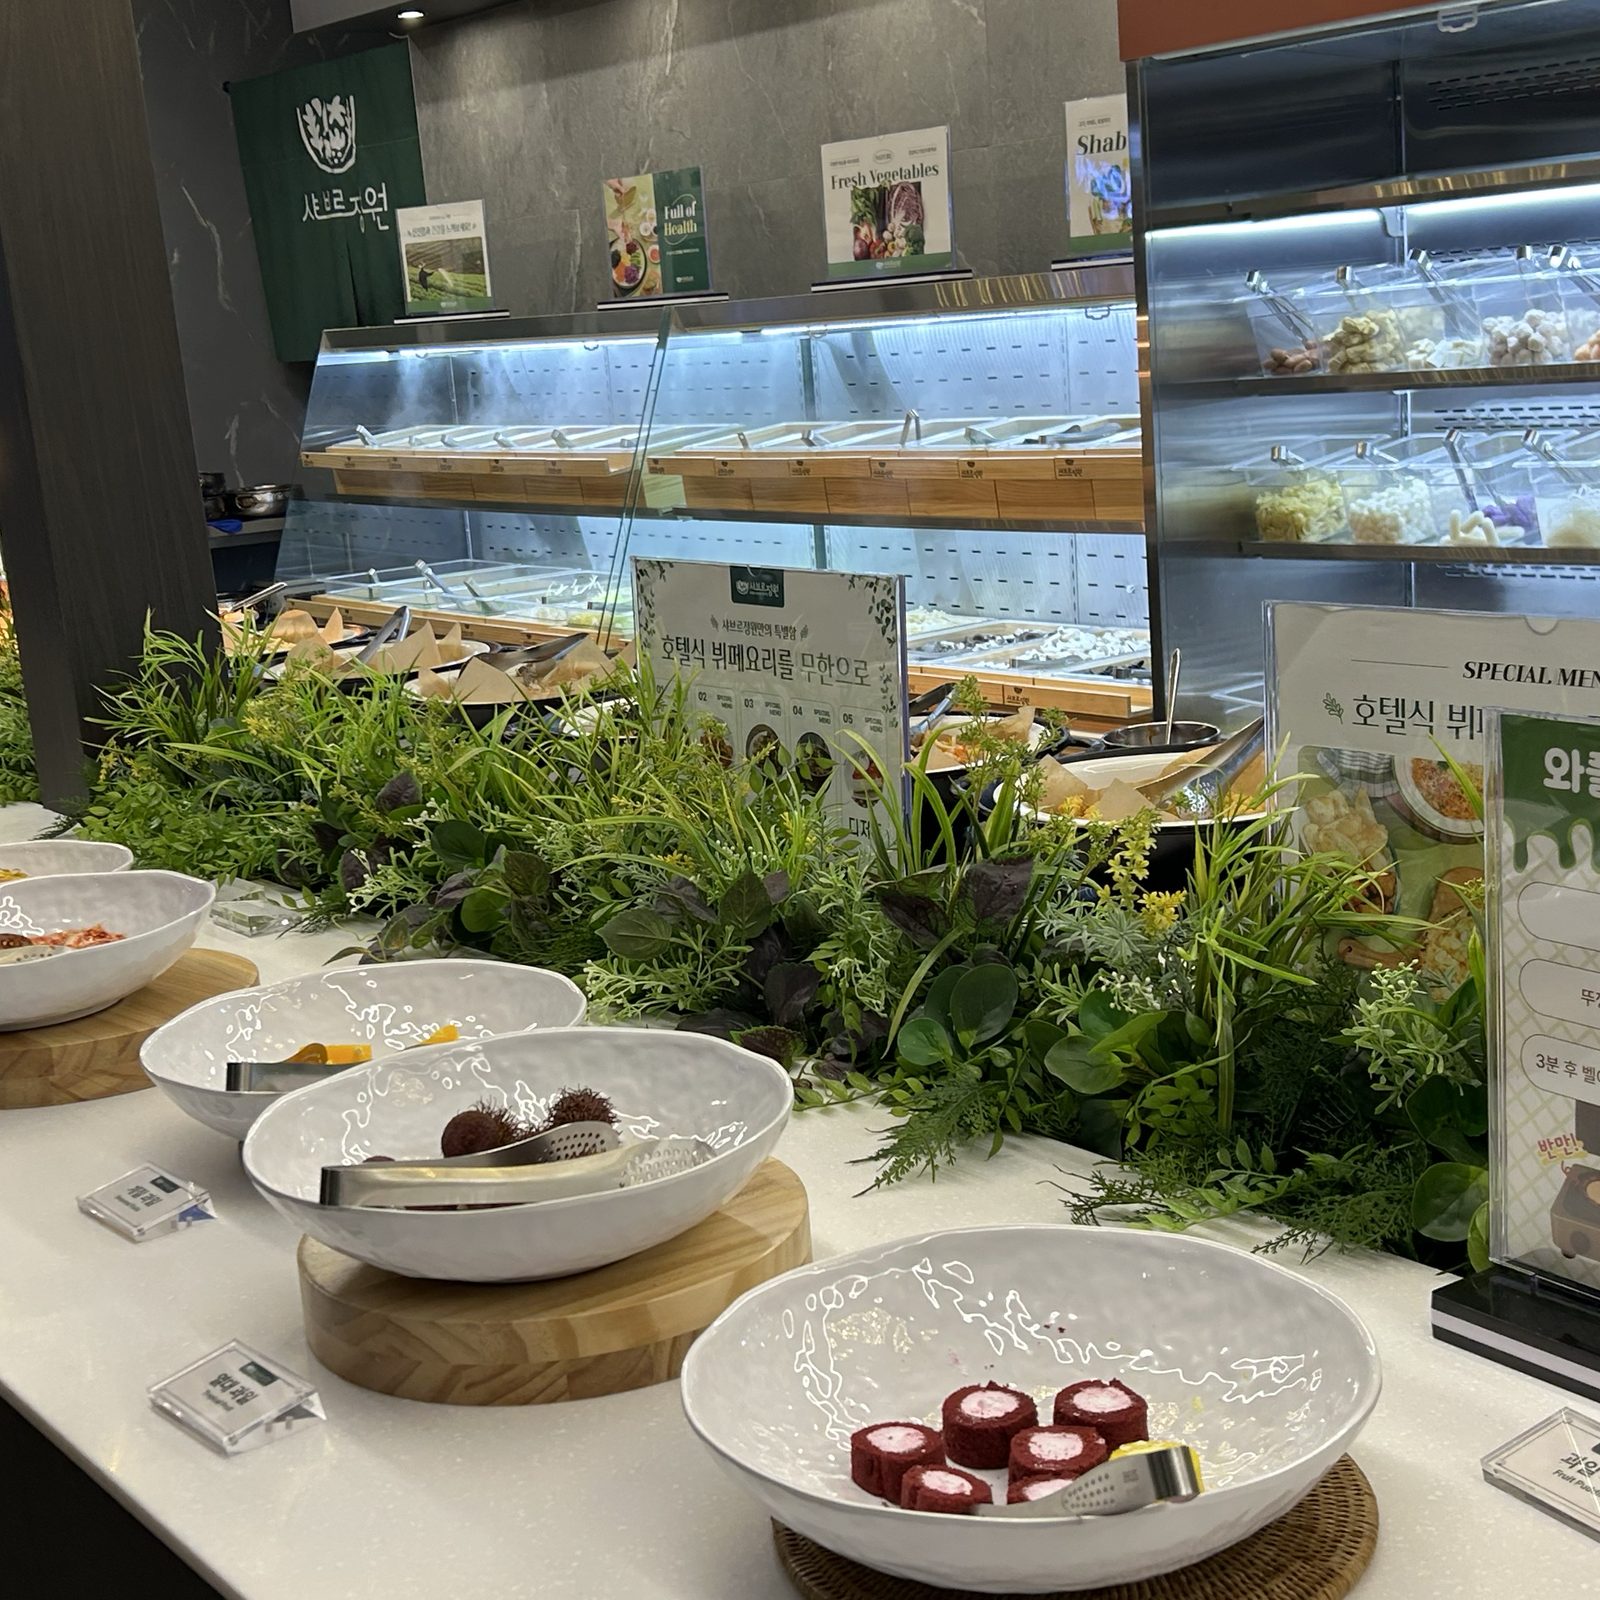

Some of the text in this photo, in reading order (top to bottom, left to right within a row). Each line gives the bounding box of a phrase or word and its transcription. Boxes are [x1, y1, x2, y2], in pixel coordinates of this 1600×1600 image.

[831, 163, 939, 190] Fresh Vegetables
[664, 200, 697, 220] Full of
[664, 219, 698, 236] Health
[721, 618, 797, 641] 샤브르정원만의 특별함
[661, 635, 872, 687] 호텔식 뷔페요리를 무한으로
[1462, 661, 1552, 685] SPECIAL
[698, 691, 707, 702] 02
[744, 698, 754, 708] 03
[792, 705, 803, 716] 04
[842, 713, 853, 724] 05
[1352, 694, 1434, 735] 호텔식
[1536, 1053, 1559, 1075] 3분
[1563, 1060, 1578, 1078] 후
[229, 1385, 259, 1405] 과일
[1560, 1452, 1600, 1478] 과일
[1552, 1469, 1577, 1483] Fruit
